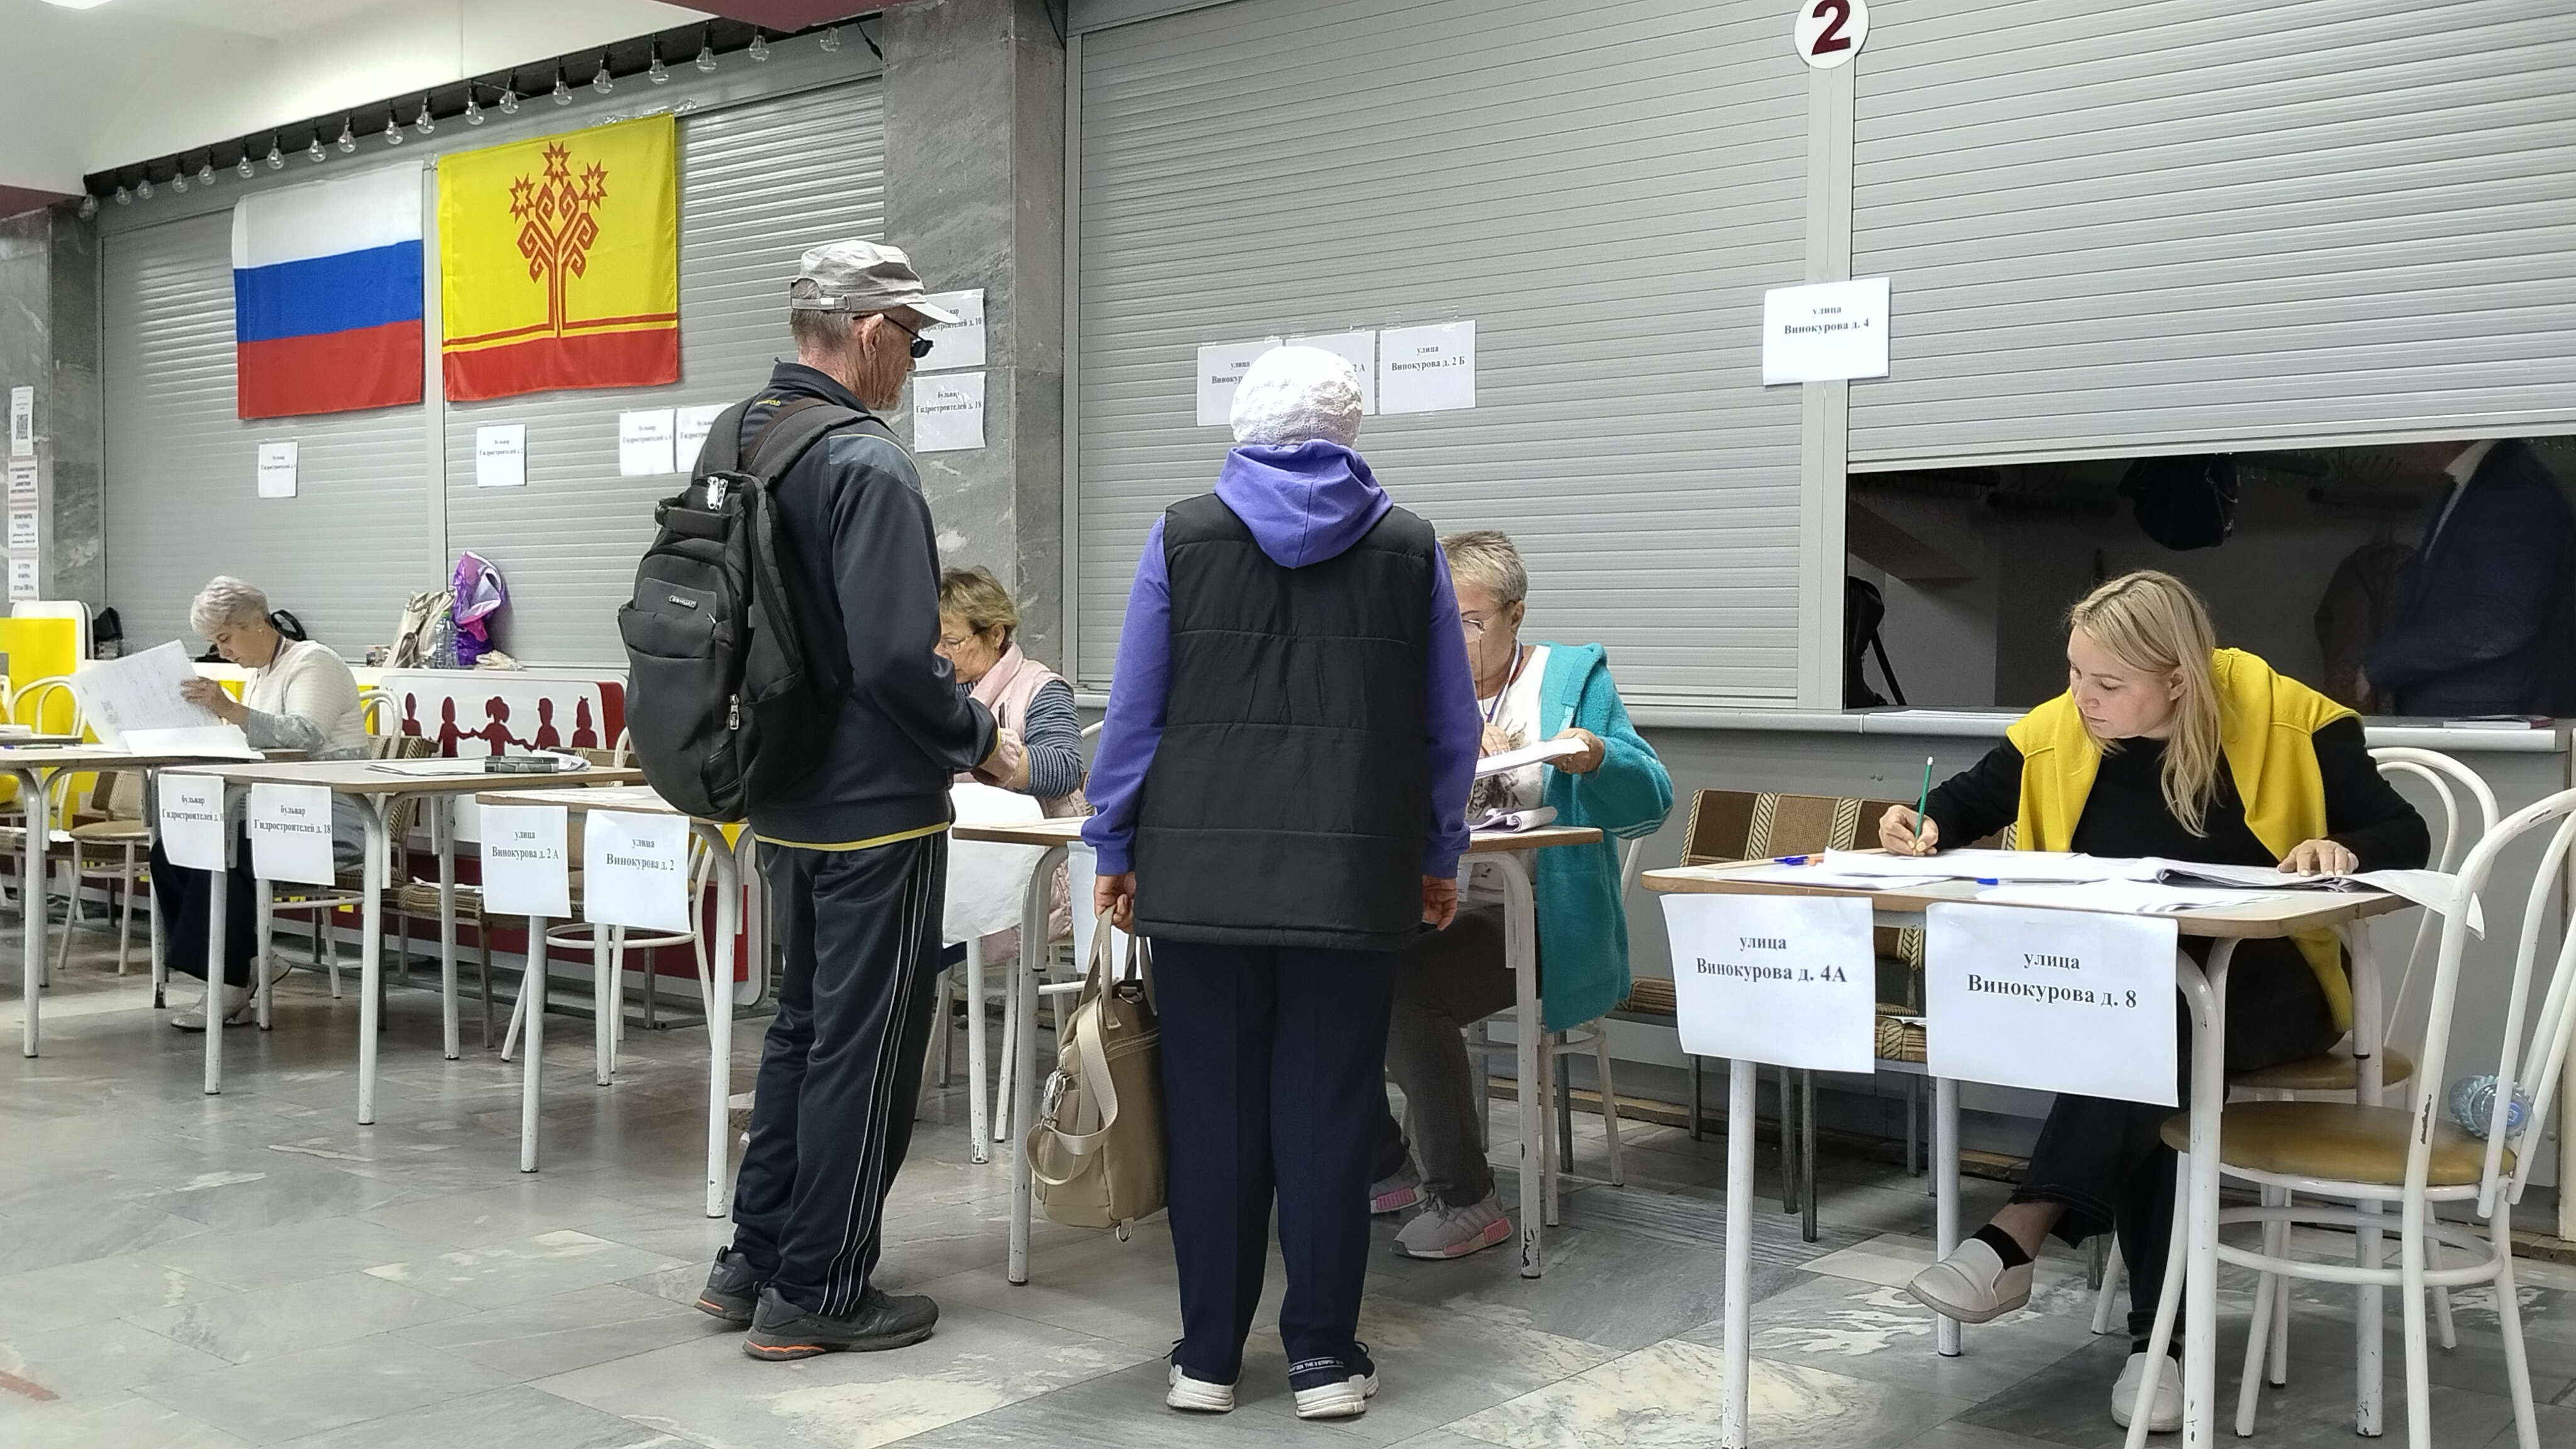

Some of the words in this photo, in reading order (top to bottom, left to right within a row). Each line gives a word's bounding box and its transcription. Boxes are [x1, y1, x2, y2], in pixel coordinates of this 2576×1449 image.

[1811, 0, 1851, 55] 2
[1813, 306, 1841, 317] улица
[1784, 321, 1848, 334] Винокурова
[1852, 321, 1860, 330] д.
[1863, 318, 1869, 328] 4
[1416, 346, 1439, 356] улица
[1230, 362, 1250, 370] улица
[1392, 360, 1440, 371] Винокурова
[1452, 357, 1457, 365] 2
[1459, 356, 1465, 365] Б
[1212, 375, 1243, 384] Винокур
[182, 794, 205, 806] бульвар
[162, 809, 213, 822] Гидростроителей
[280, 805, 306, 817] бульвар
[254, 819, 314, 833] Гидростроителей
[324, 824, 331, 834] 18
[514, 831, 535, 841] улица
[632, 839, 655, 849] улица
[492, 846, 537, 860] Винокурова
[547, 848, 551, 858] 2
[553, 849, 558, 859] А
[606, 853, 659, 870] Винокурова
[660, 861, 667, 870] д.
[670, 859, 674, 870] 2
[1740, 936, 1787, 951] улица
[2024, 953, 2080, 970] улица
[1696, 957, 1792, 982] Винокурова
[1798, 969, 1814, 982] д.
[1821, 965, 1847, 982] 4А
[1967, 974, 2094, 1003] Винокурова
[2101, 992, 2118, 1008] д.
[2125, 990, 2137, 1008] 8
